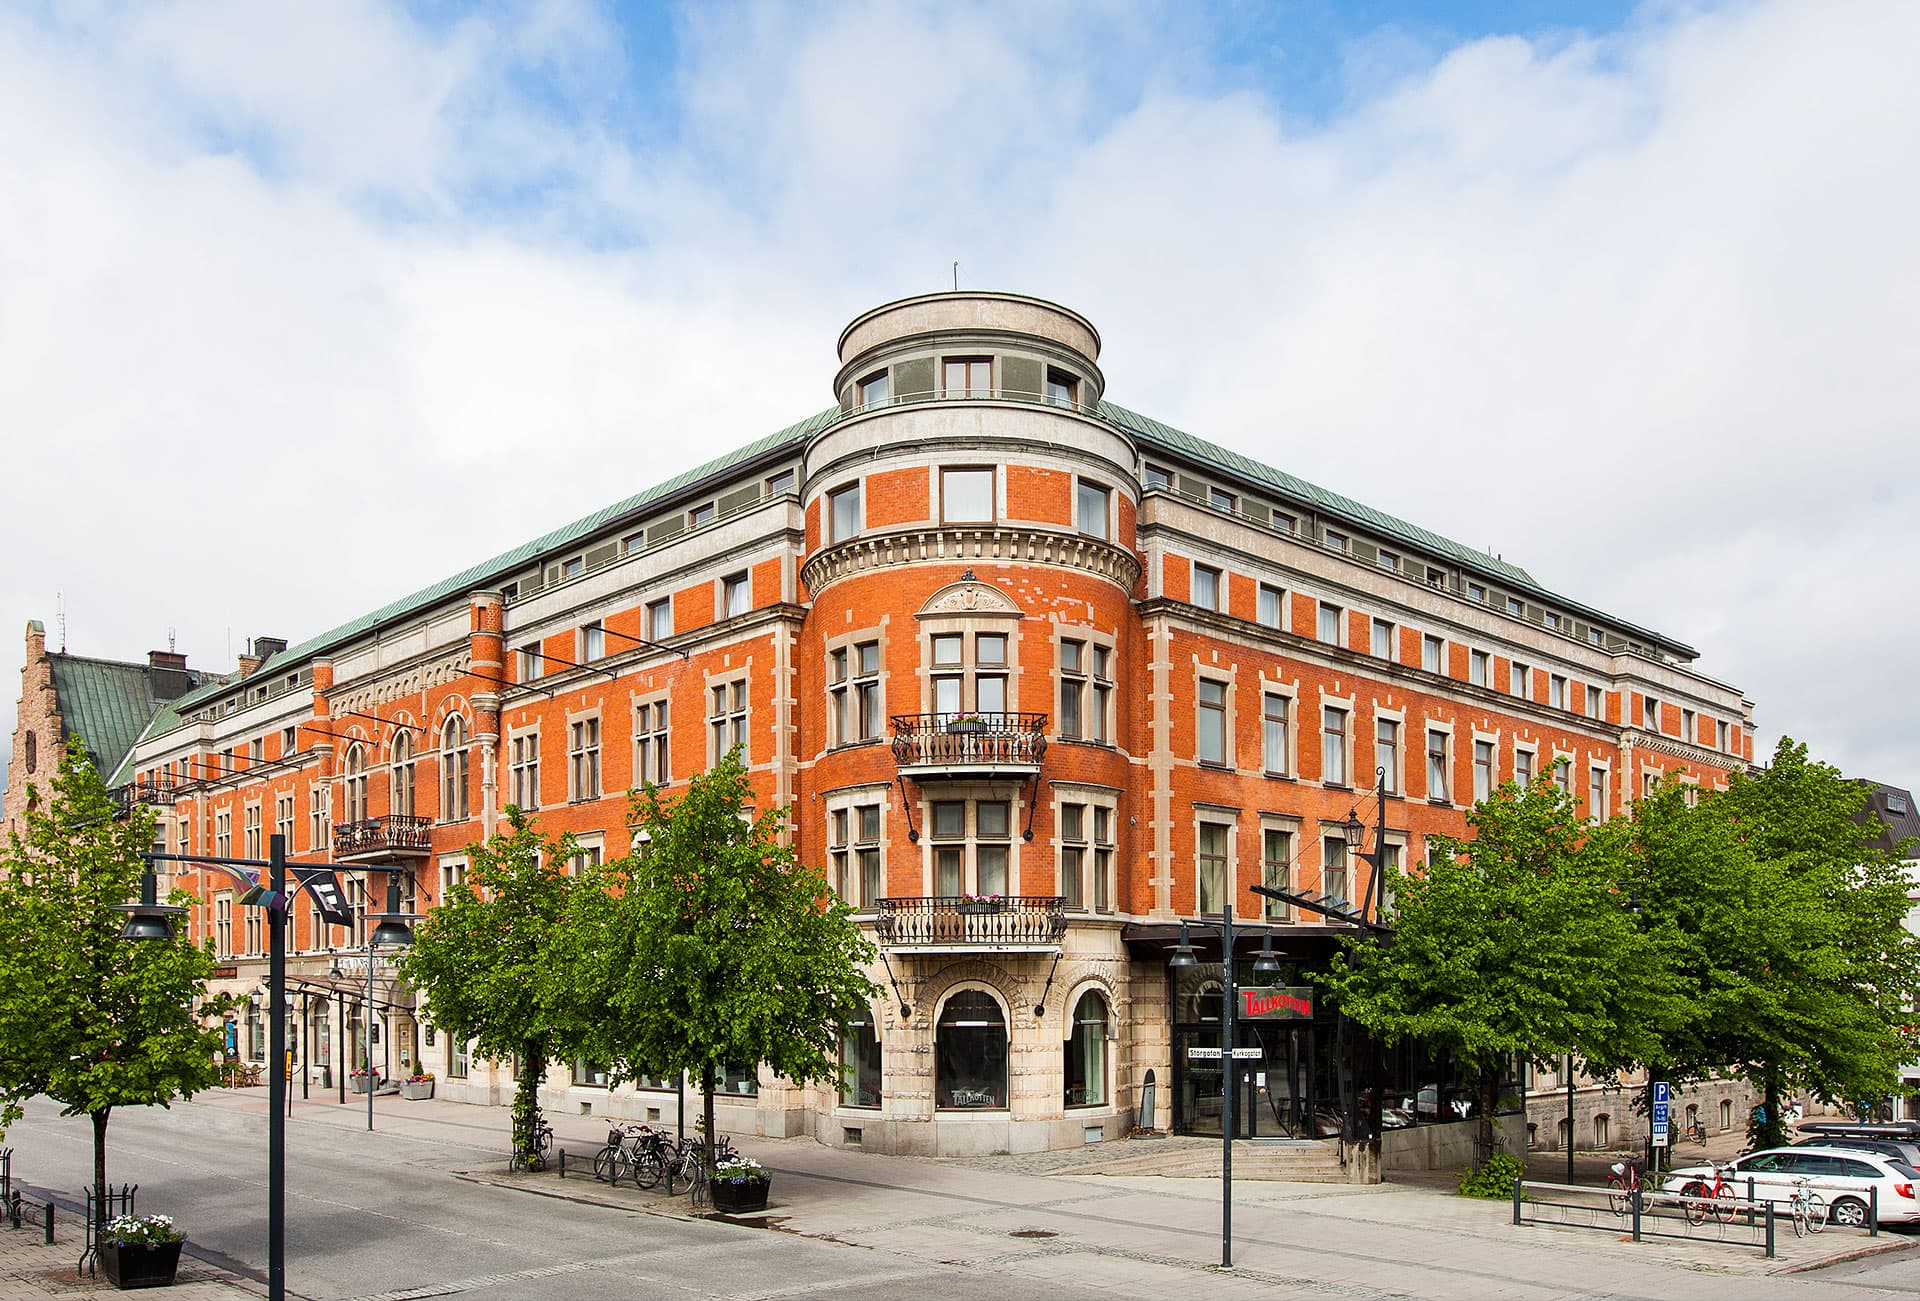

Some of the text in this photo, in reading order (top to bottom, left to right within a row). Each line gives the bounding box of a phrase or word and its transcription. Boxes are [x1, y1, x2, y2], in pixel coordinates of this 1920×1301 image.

[1241, 991, 1311, 1016] TALLKOTTEN
[1189, 1049, 1221, 1058] Storgatan
[1658, 1084, 1666, 1101] P
